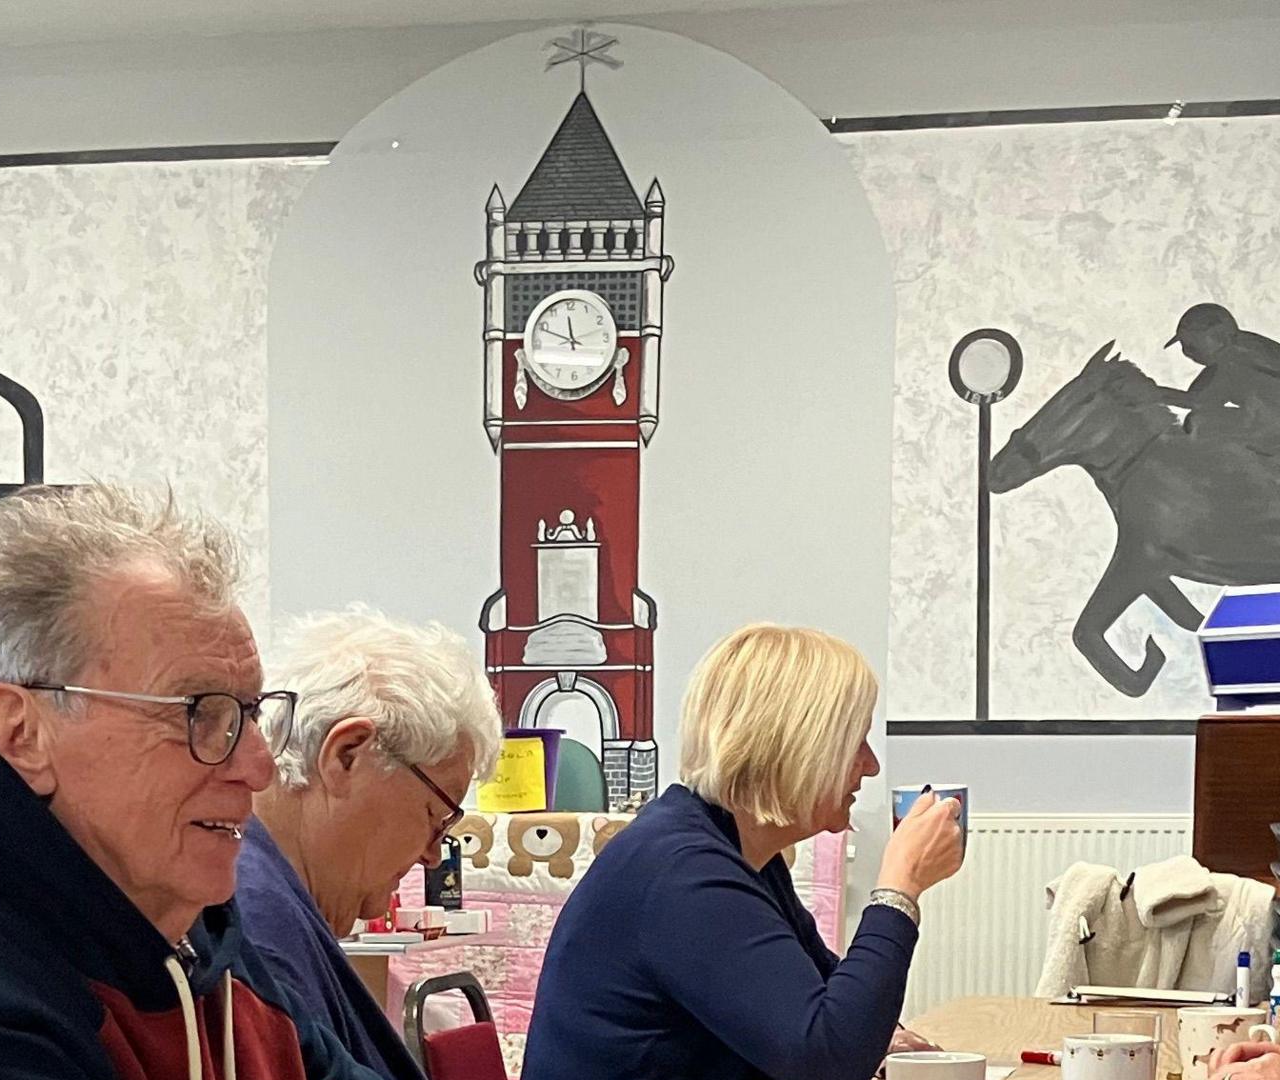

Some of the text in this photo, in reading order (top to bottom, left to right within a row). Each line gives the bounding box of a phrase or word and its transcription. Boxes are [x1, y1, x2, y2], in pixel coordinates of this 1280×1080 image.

[565, 300, 576, 311] 12
[596, 315, 604, 326] 2
[602, 332, 609, 343] 3
[571, 370, 578, 381] 6
